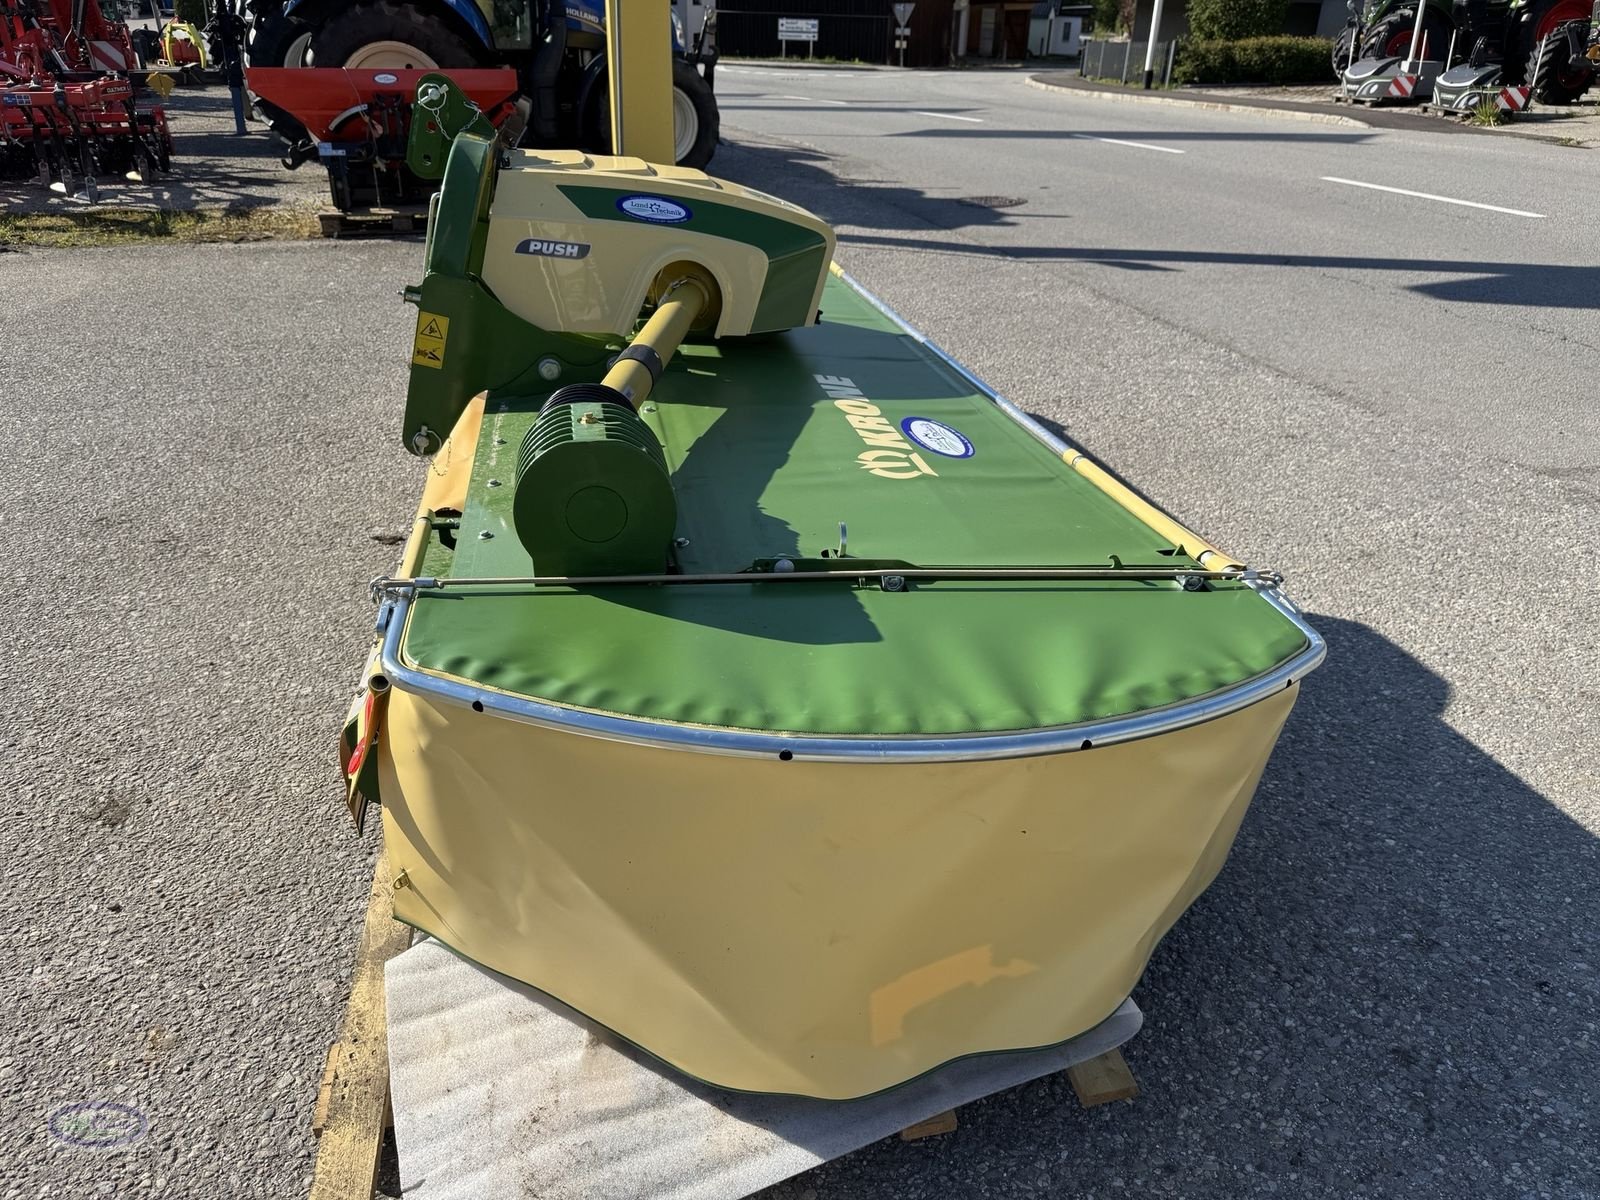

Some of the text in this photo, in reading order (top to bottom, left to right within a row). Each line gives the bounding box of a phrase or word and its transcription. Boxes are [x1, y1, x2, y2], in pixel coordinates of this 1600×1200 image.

[566, 7, 598, 23] HOLLAND
[631, 200, 649, 209] Land
[655, 207, 682, 217] Technik
[528, 240, 579, 257] PUSH
[813, 374, 913, 451] KRONE
